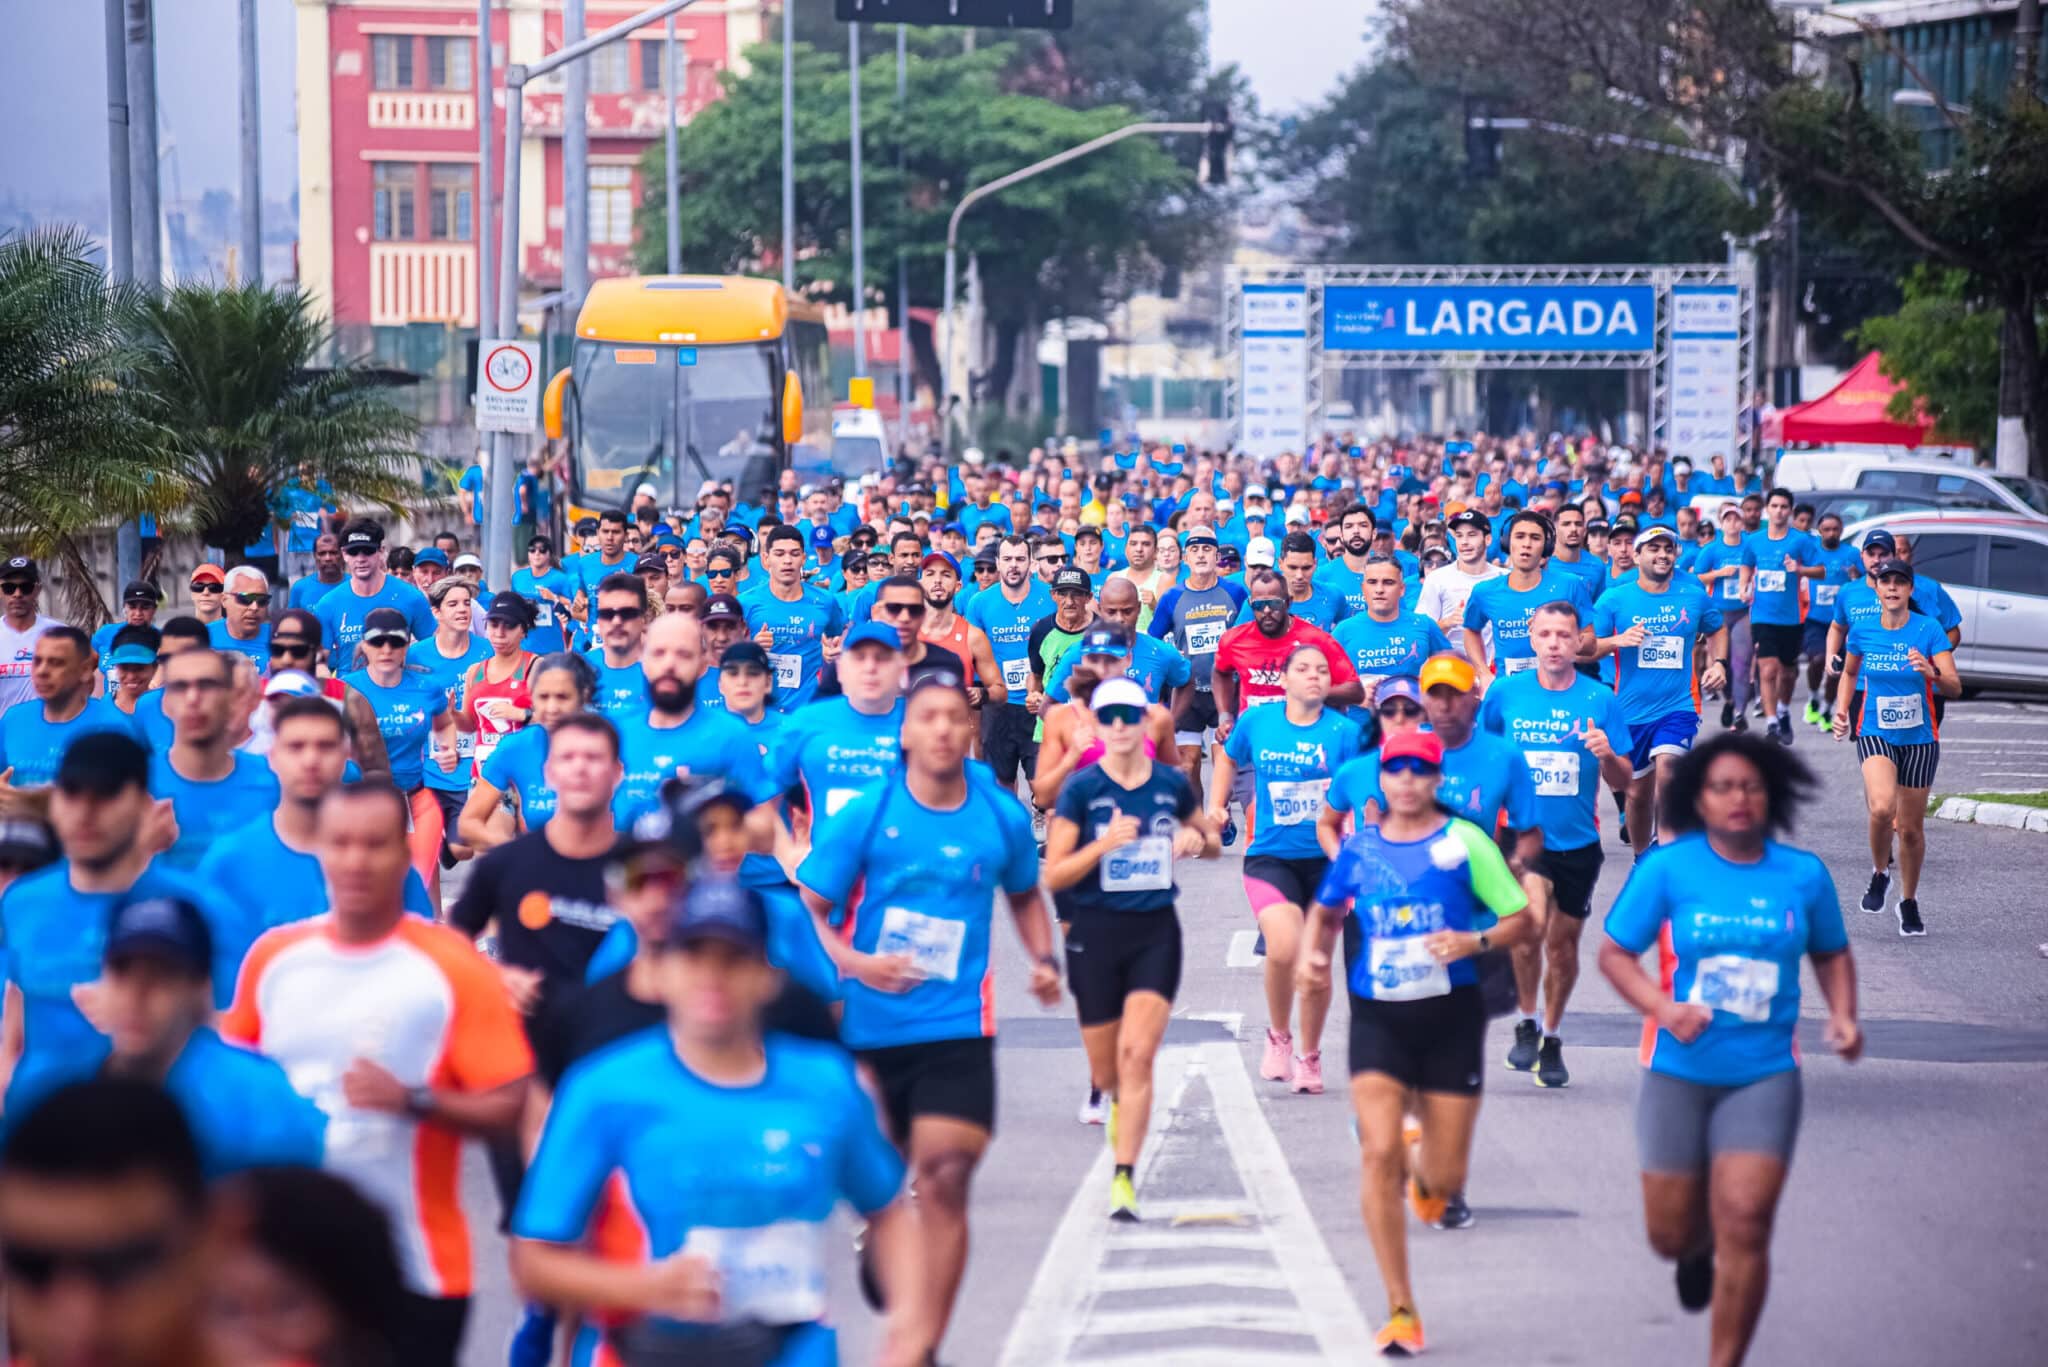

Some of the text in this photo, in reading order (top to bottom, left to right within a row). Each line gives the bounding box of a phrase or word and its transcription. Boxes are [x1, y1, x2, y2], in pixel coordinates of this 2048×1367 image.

[1405, 299, 1638, 336] LARGADA
[1632, 614, 1677, 625] Corrida
[769, 625, 804, 635] orrida
[992, 624, 1031, 635] Corrida
[1358, 646, 1407, 659] Corrida
[1642, 647, 1677, 661] 50594
[1357, 658, 1397, 670] FAESA
[1880, 709, 1917, 723] 50027
[1512, 718, 1570, 732] Corrida
[1512, 732, 1559, 745] FAESA
[1260, 749, 1314, 766] Corrida
[1274, 798, 1319, 817] 50015
